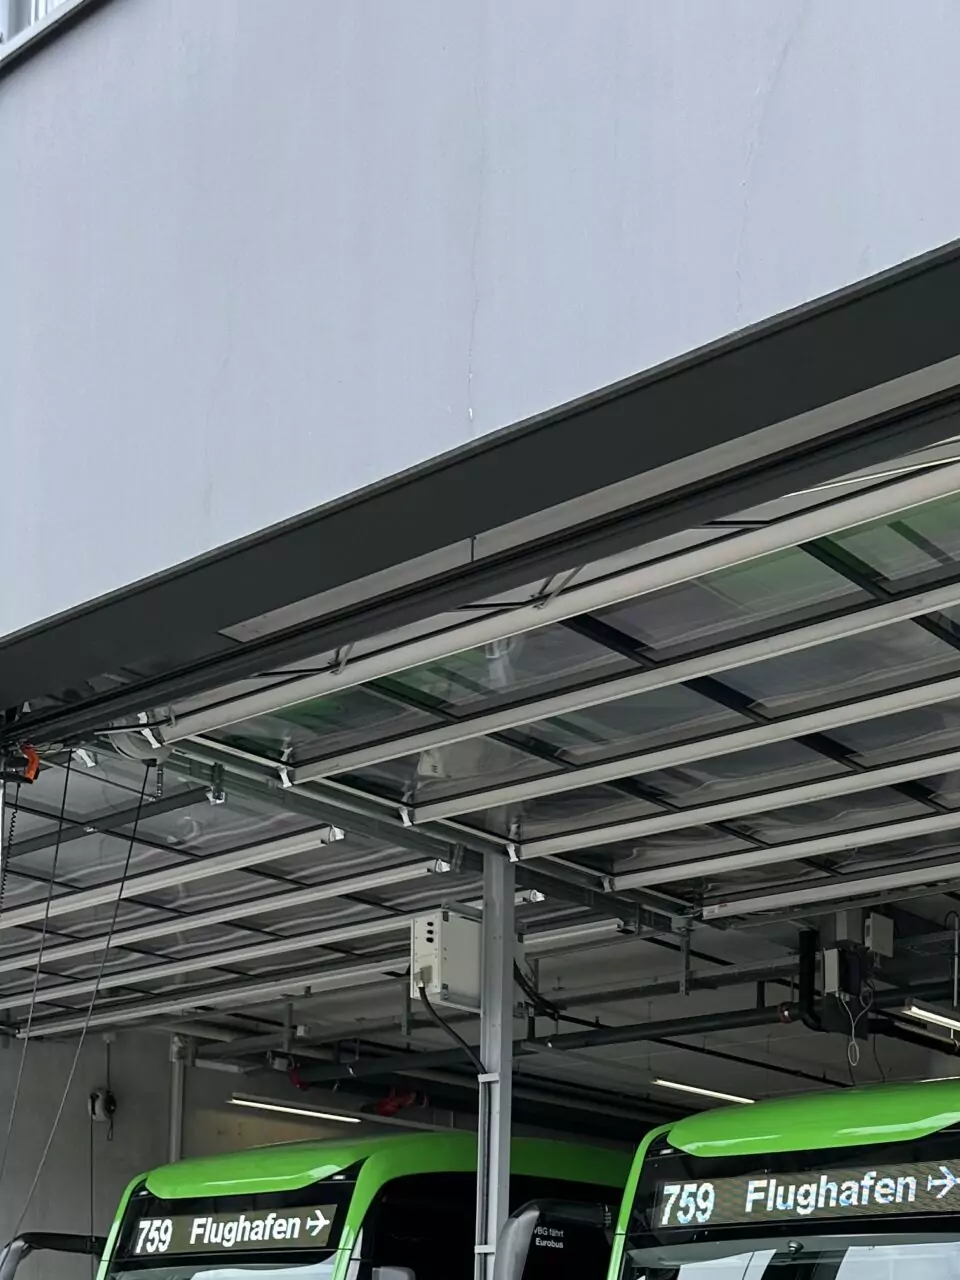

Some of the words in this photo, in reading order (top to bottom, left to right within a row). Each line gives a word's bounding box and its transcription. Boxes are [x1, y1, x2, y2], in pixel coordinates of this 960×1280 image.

[660, 1183, 715, 1225] 759
[745, 1171, 917, 1215] Flughafen
[134, 1219, 173, 1254] 759
[189, 1213, 301, 1247] Flughafen
[535, 1237, 564, 1248] Eurobus
